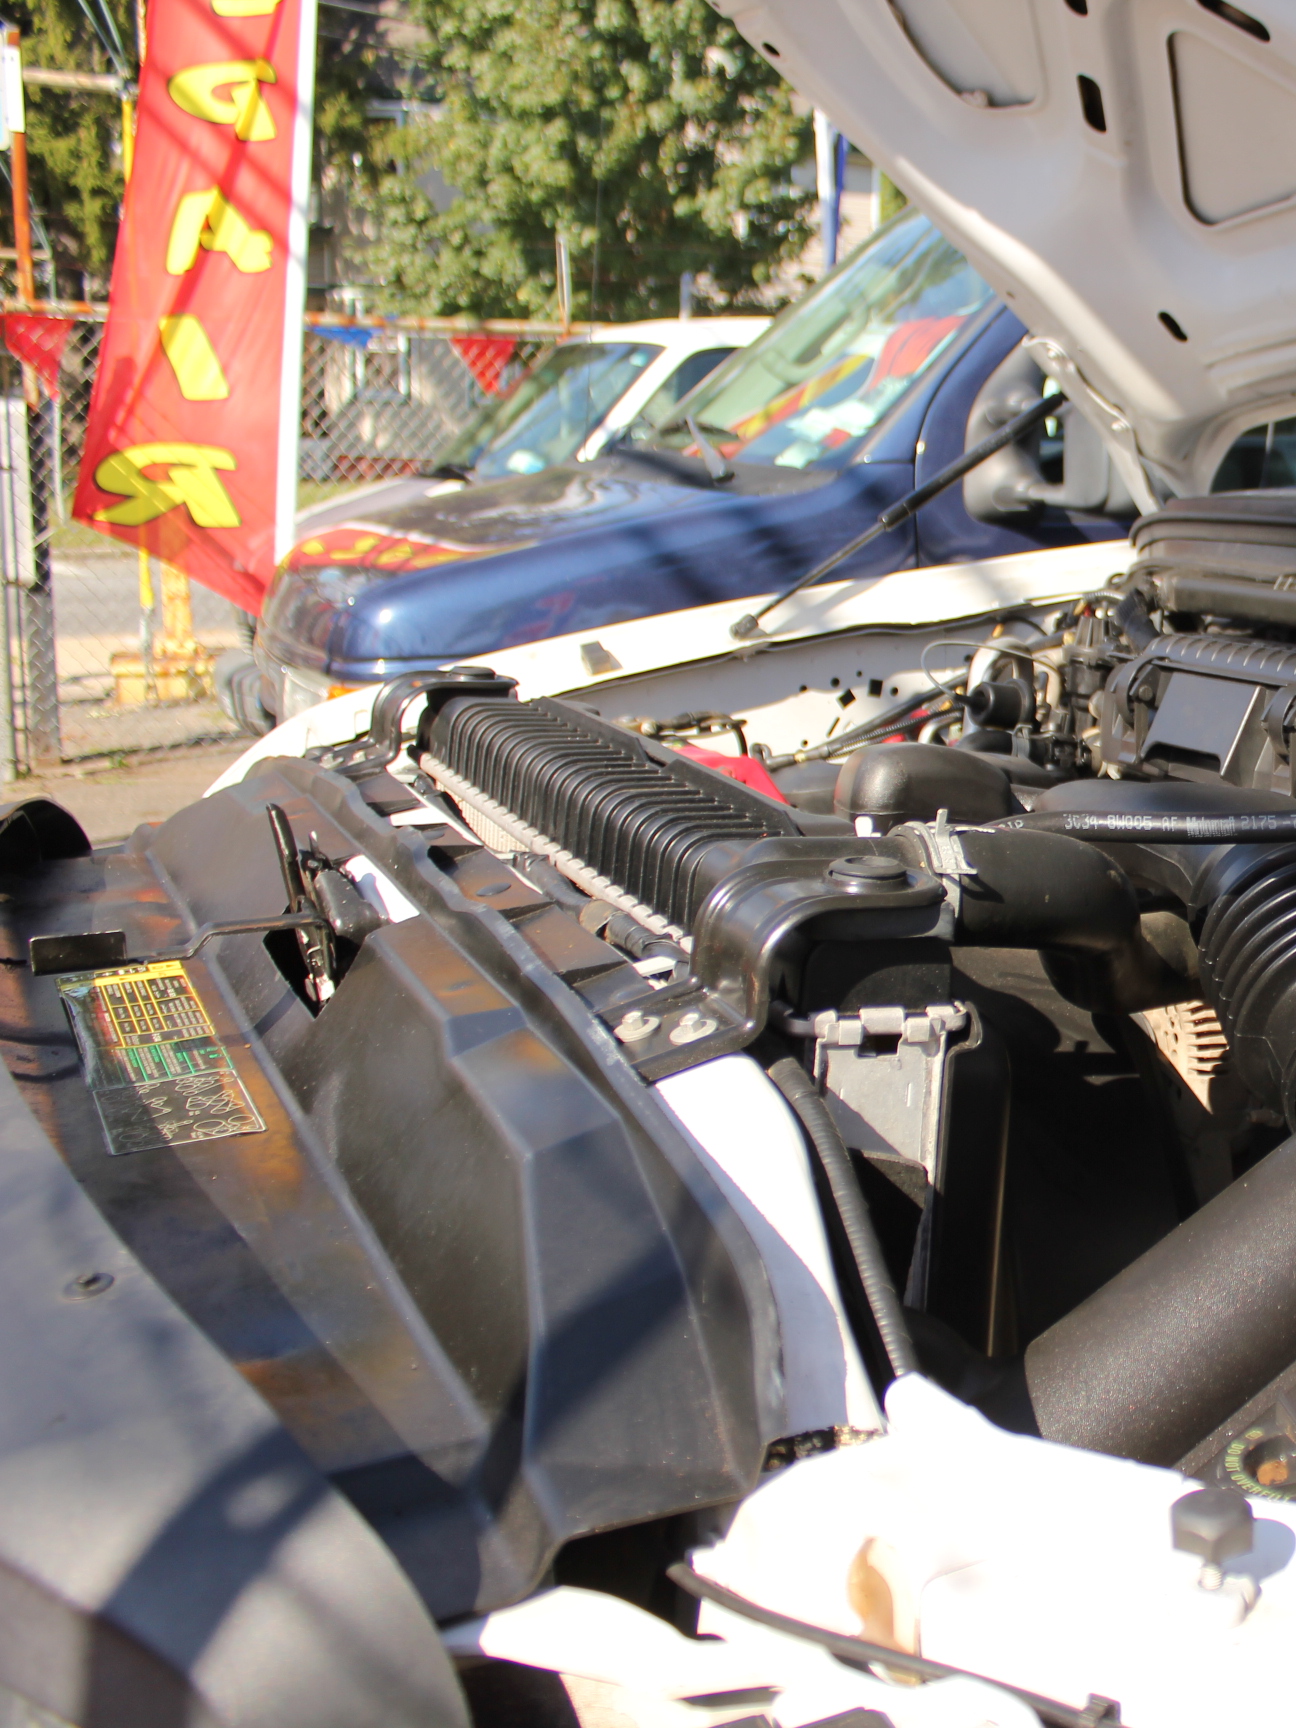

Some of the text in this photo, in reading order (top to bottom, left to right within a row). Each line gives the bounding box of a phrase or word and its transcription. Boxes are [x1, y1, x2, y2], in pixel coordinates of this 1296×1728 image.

[1240, 815, 1278, 830] 2175
[1226, 1443, 1245, 1455] DO
[1224, 1456, 1241, 1472] NOT
